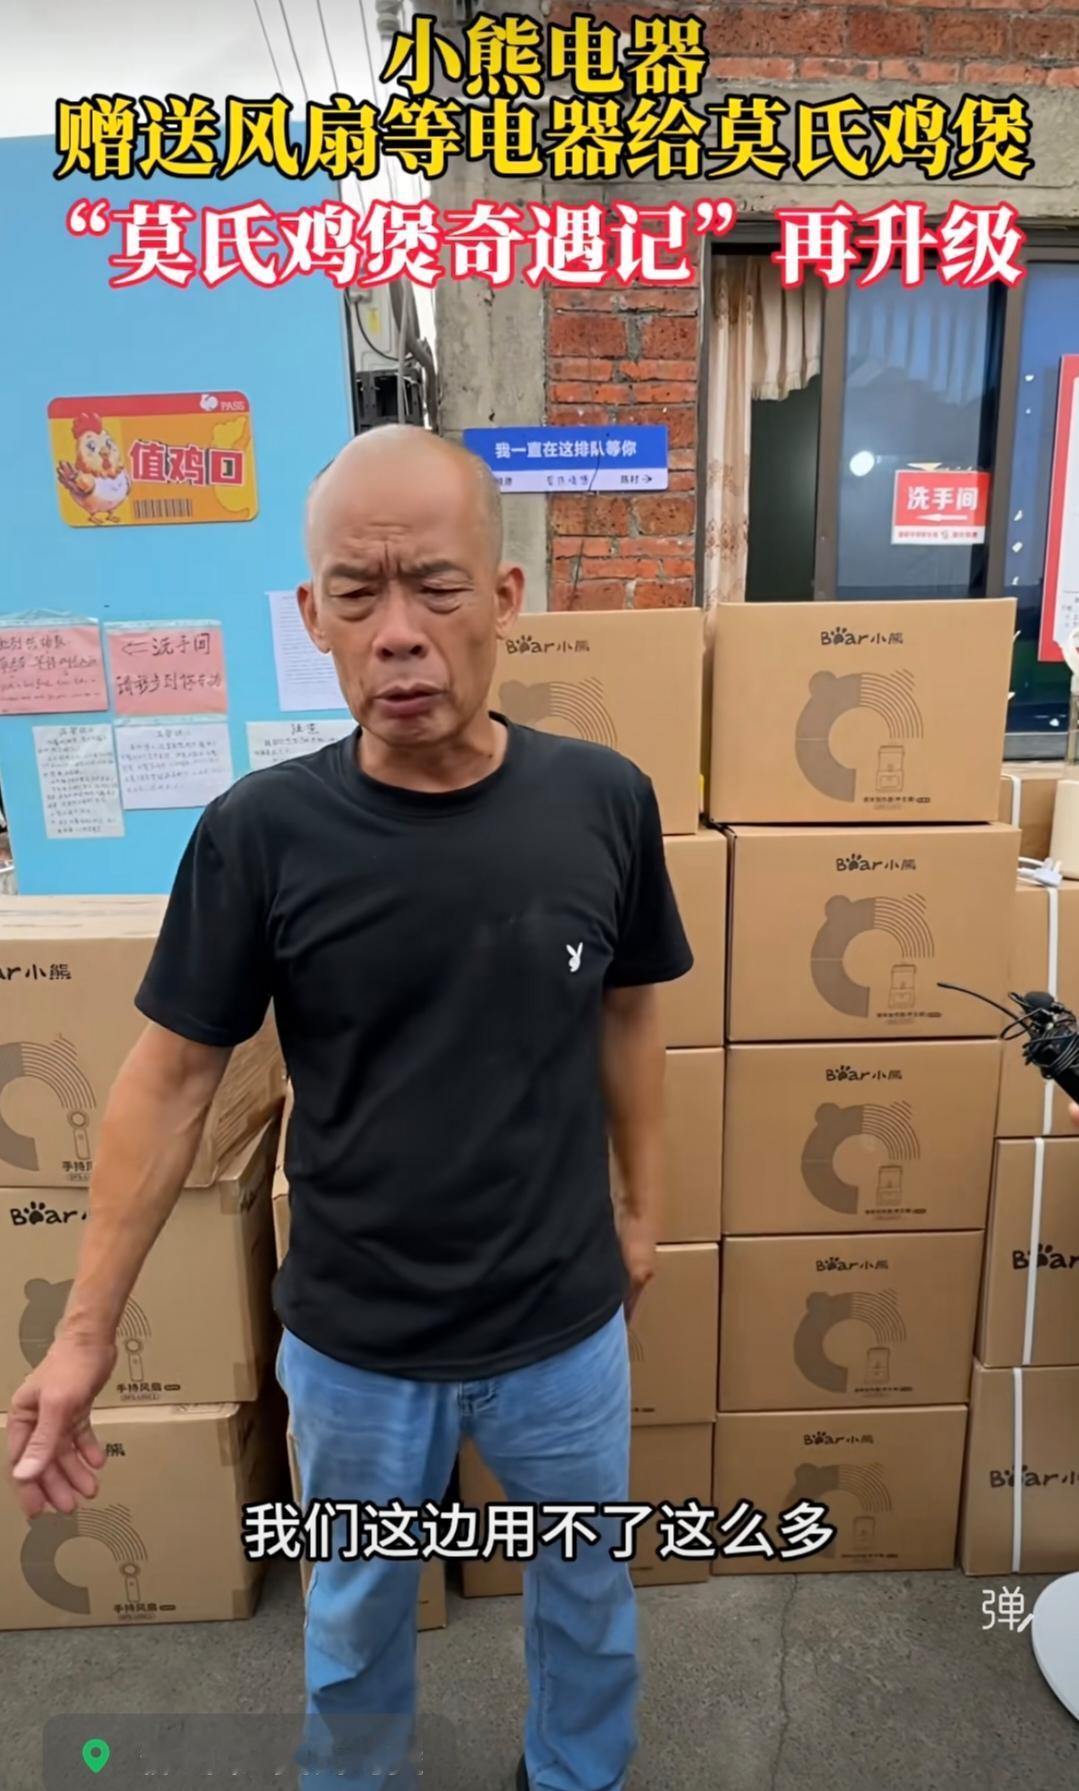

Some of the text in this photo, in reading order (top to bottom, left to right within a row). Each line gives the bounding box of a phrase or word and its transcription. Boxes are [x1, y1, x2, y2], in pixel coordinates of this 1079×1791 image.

[495, 440, 637, 458] 我一直在这排队等你
[130, 439, 244, 486] 值鸡口
[906, 486, 978, 510] 洗手间
[151, 632, 211, 656] 洗手间
